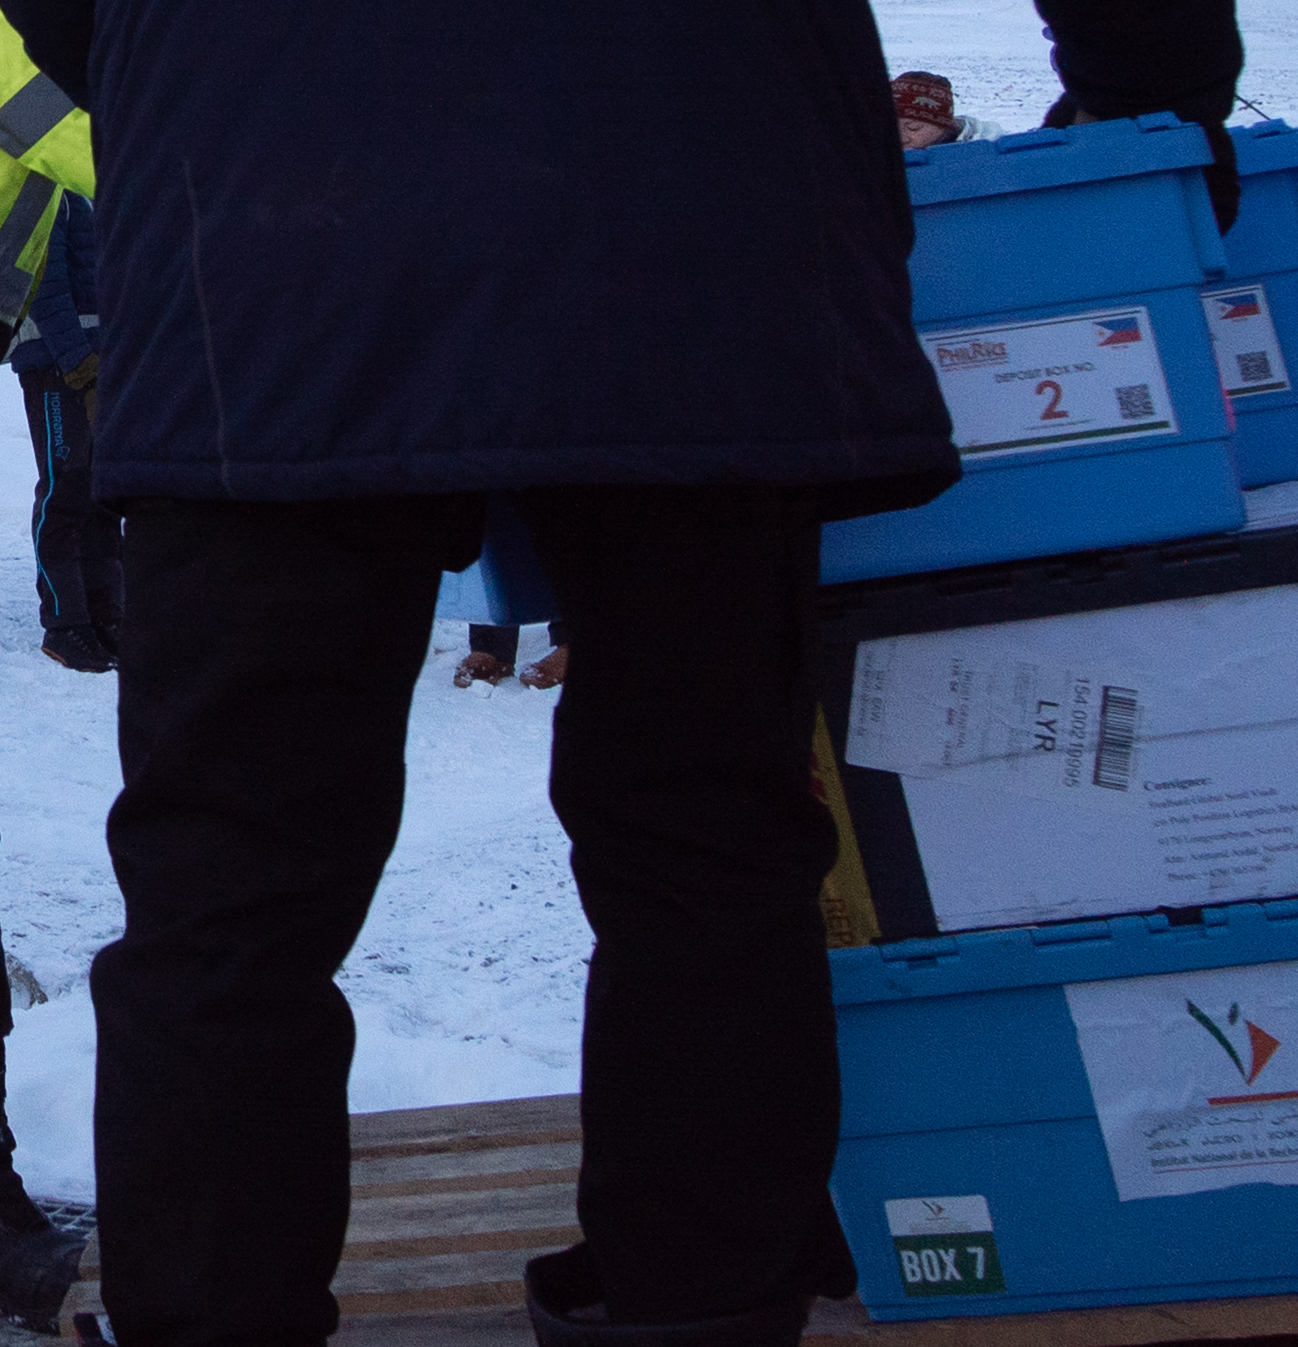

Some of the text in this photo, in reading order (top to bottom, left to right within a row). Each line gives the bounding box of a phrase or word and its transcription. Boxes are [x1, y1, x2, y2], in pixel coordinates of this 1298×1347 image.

[1035, 380, 1069, 421] 2
[1034, 700, 1059, 753] LYR
[825, 898, 855, 949] REP
[901, 1246, 985, 1283] BOX 7
